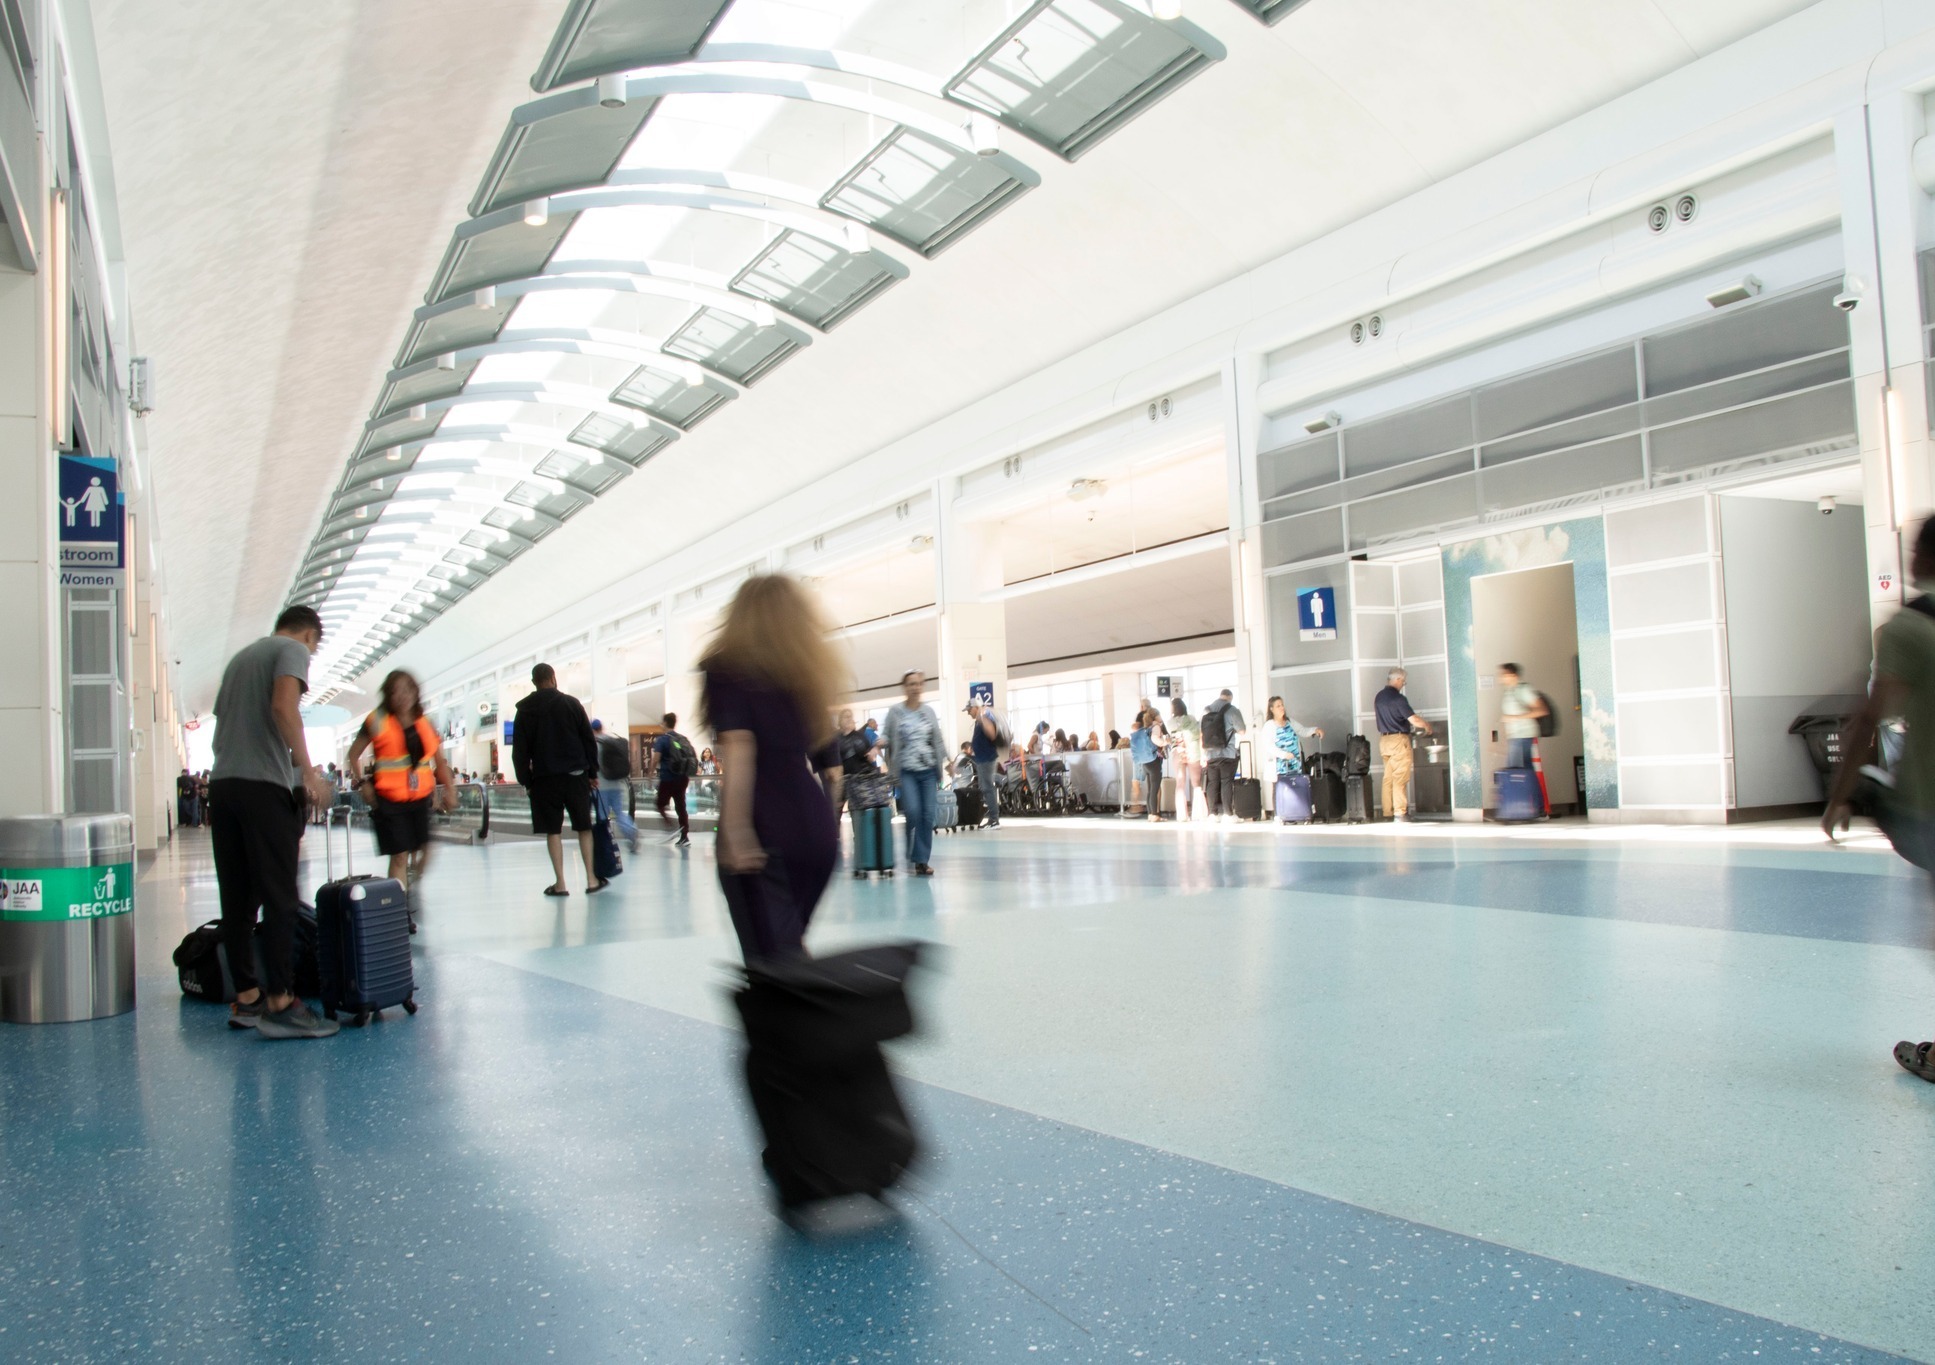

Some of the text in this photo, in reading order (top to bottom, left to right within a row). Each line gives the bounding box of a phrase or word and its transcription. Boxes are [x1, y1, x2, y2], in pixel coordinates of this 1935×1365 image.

[975, 692, 992, 706] A2
[13, 882, 40, 895] JAA
[69, 898, 131, 918] RECYCLE
